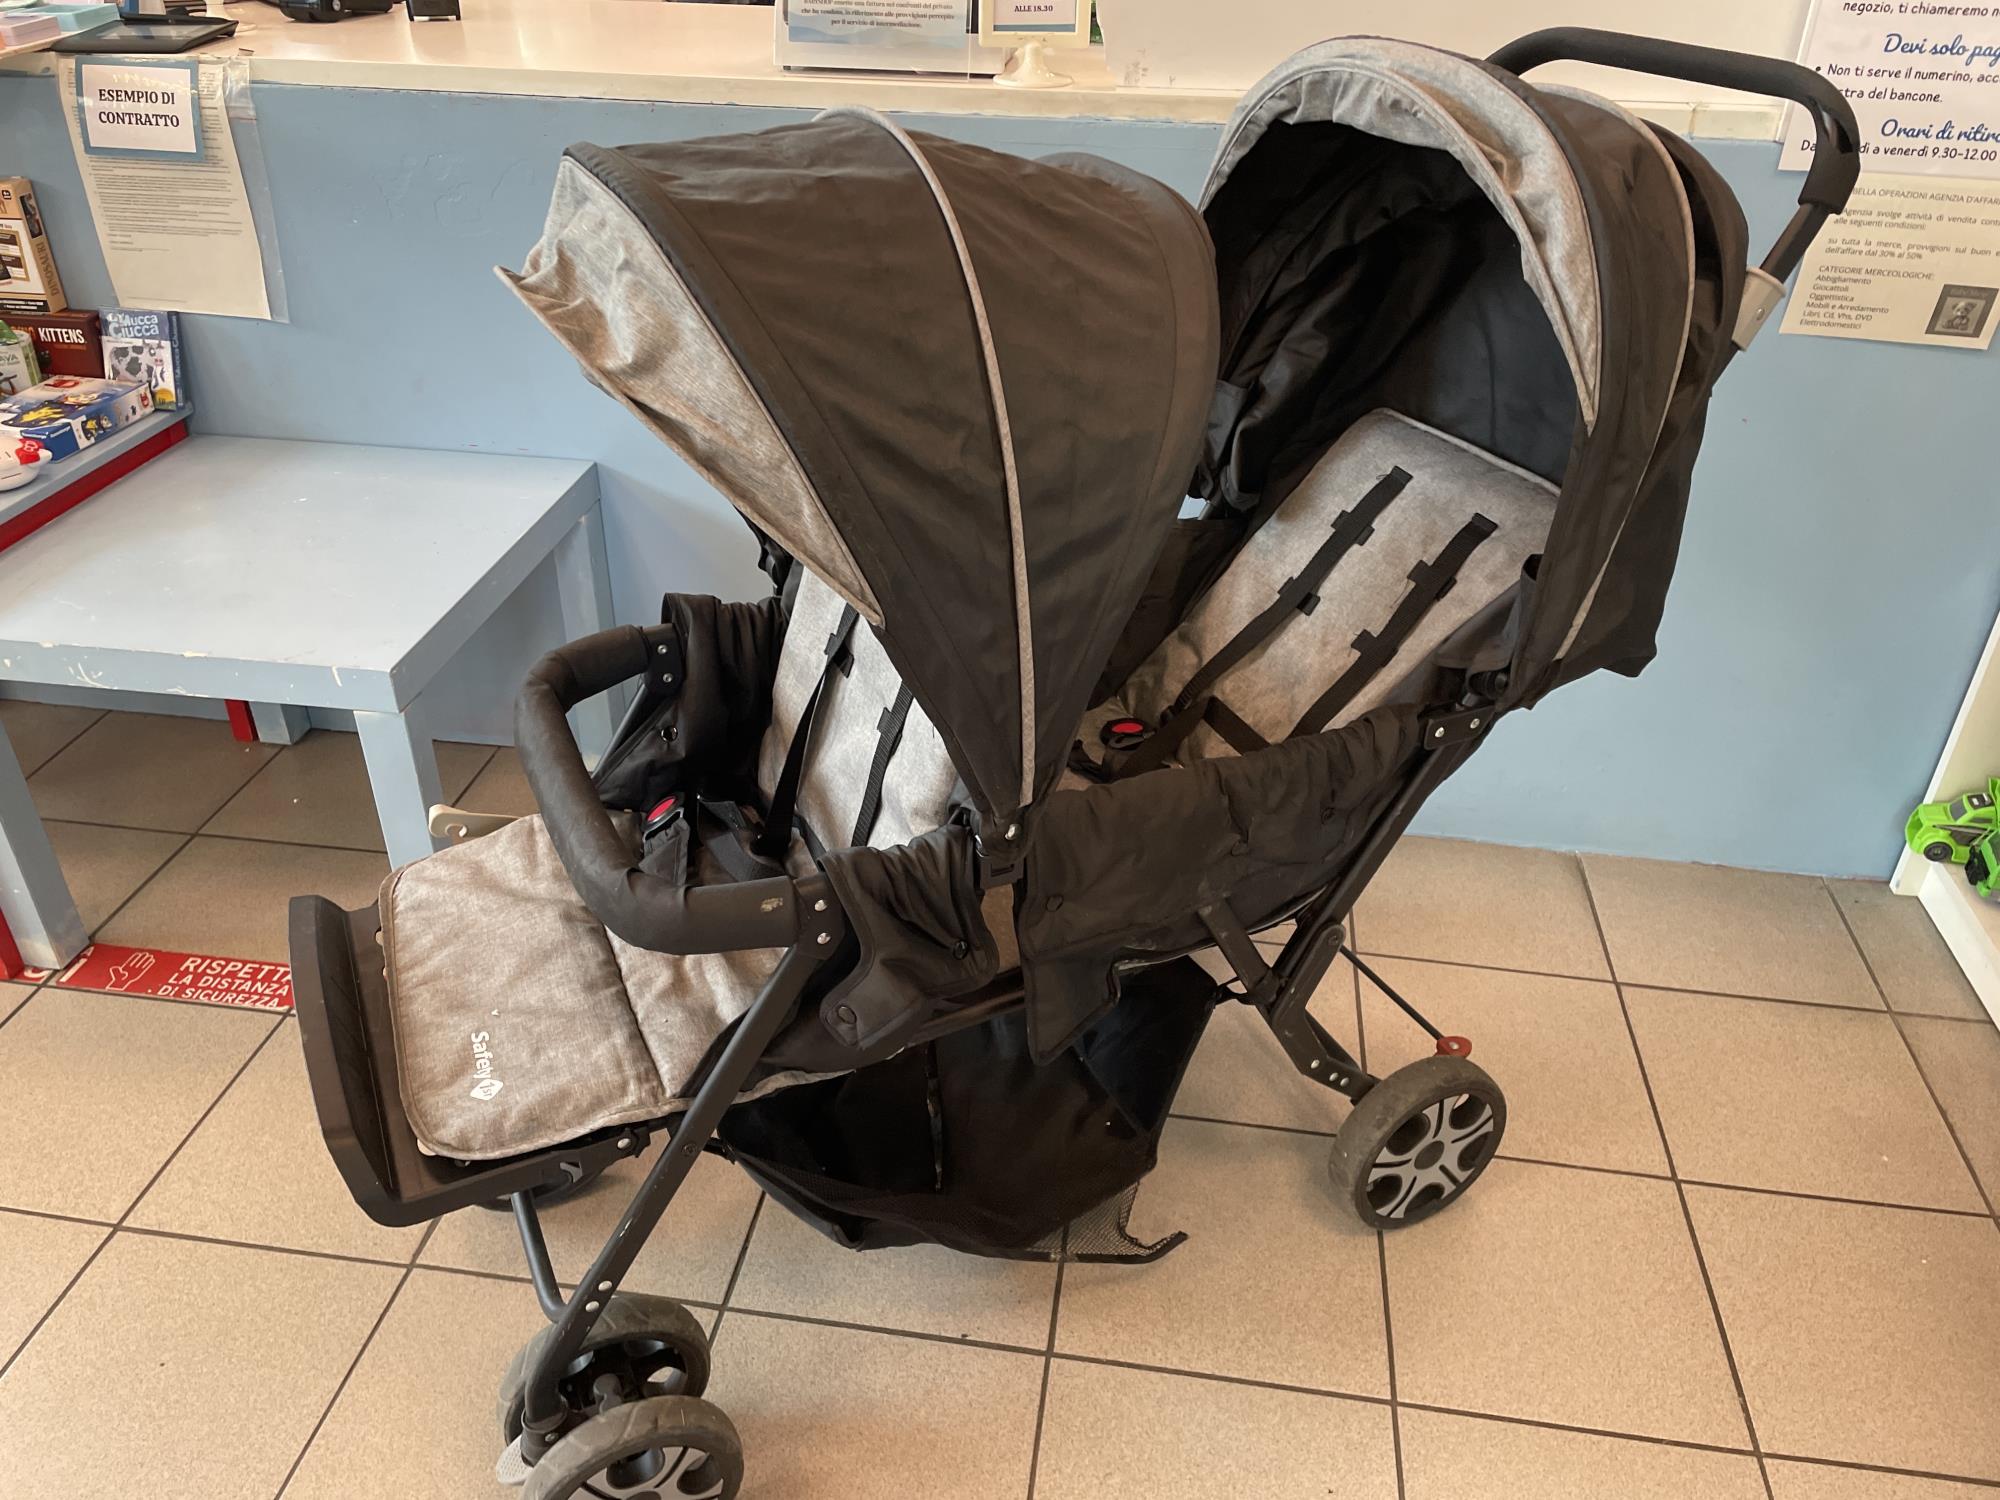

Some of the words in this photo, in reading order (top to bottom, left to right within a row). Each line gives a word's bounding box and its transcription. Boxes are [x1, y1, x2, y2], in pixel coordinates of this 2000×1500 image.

[1843, 2, 1894, 15] negozio,
[1899, 3, 1908, 13] ti
[1911, 2, 1989, 16] chiameremo
[1883, 33, 1927, 54] Devi
[1929, 34, 1969, 55] solo
[1827, 63, 1851, 76] Non
[1855, 66, 1865, 77] ti
[1866, 68, 1901, 78] serve
[1904, 66, 1913, 79] il
[1914, 70, 1973, 83] numerino,
[98, 88, 158, 104] ESEMPIO
[161, 92, 175, 105] DI
[1868, 86, 1888, 99] del
[1889, 87, 1943, 103] bancone.
[98, 111, 180, 127] CONTRATTO
[1881, 118, 1933, 139] Orari
[1935, 120, 1955, 140] di
[1872, 146, 1880, 154] a
[1932, 146, 1997, 161] 9.30-12.00
[1852, 187, 1876, 196] BELLA
[1879, 189, 1928, 200] OPERAZIONI
[1929, 193, 1964, 202] AGENZIA
[1850, 219, 1883, 228] seguenti
[1877, 210, 1902, 219] svolge
[1936, 214, 1944, 222] di
[1948, 215, 1977, 224] vendita
[1842, 238, 1861, 246] tutta
[1865, 248, 1878, 256] dal
[1819, 265, 1862, 275] CATEGORIE
[1813, 283, 1849, 291] Giocattoli
[1816, 274, 1872, 285] Abbigliamento
[1809, 292, 1855, 302] Oggettistica
[1806, 301, 1830, 309] Mobili
[1838, 304, 1889, 313] Arredamento
[108, 323, 159, 338] Ciucca
[1800, 318, 1862, 329] Elettrodomestici
[38, 327, 85, 343] KITTENS
[168, 973, 193, 985] LA
[197, 976, 290, 996] DISTANZA
[157, 985, 179, 996] DI
[182, 987, 280, 1008] SICUREZZA
[471, 1031, 493, 1079] Safety
